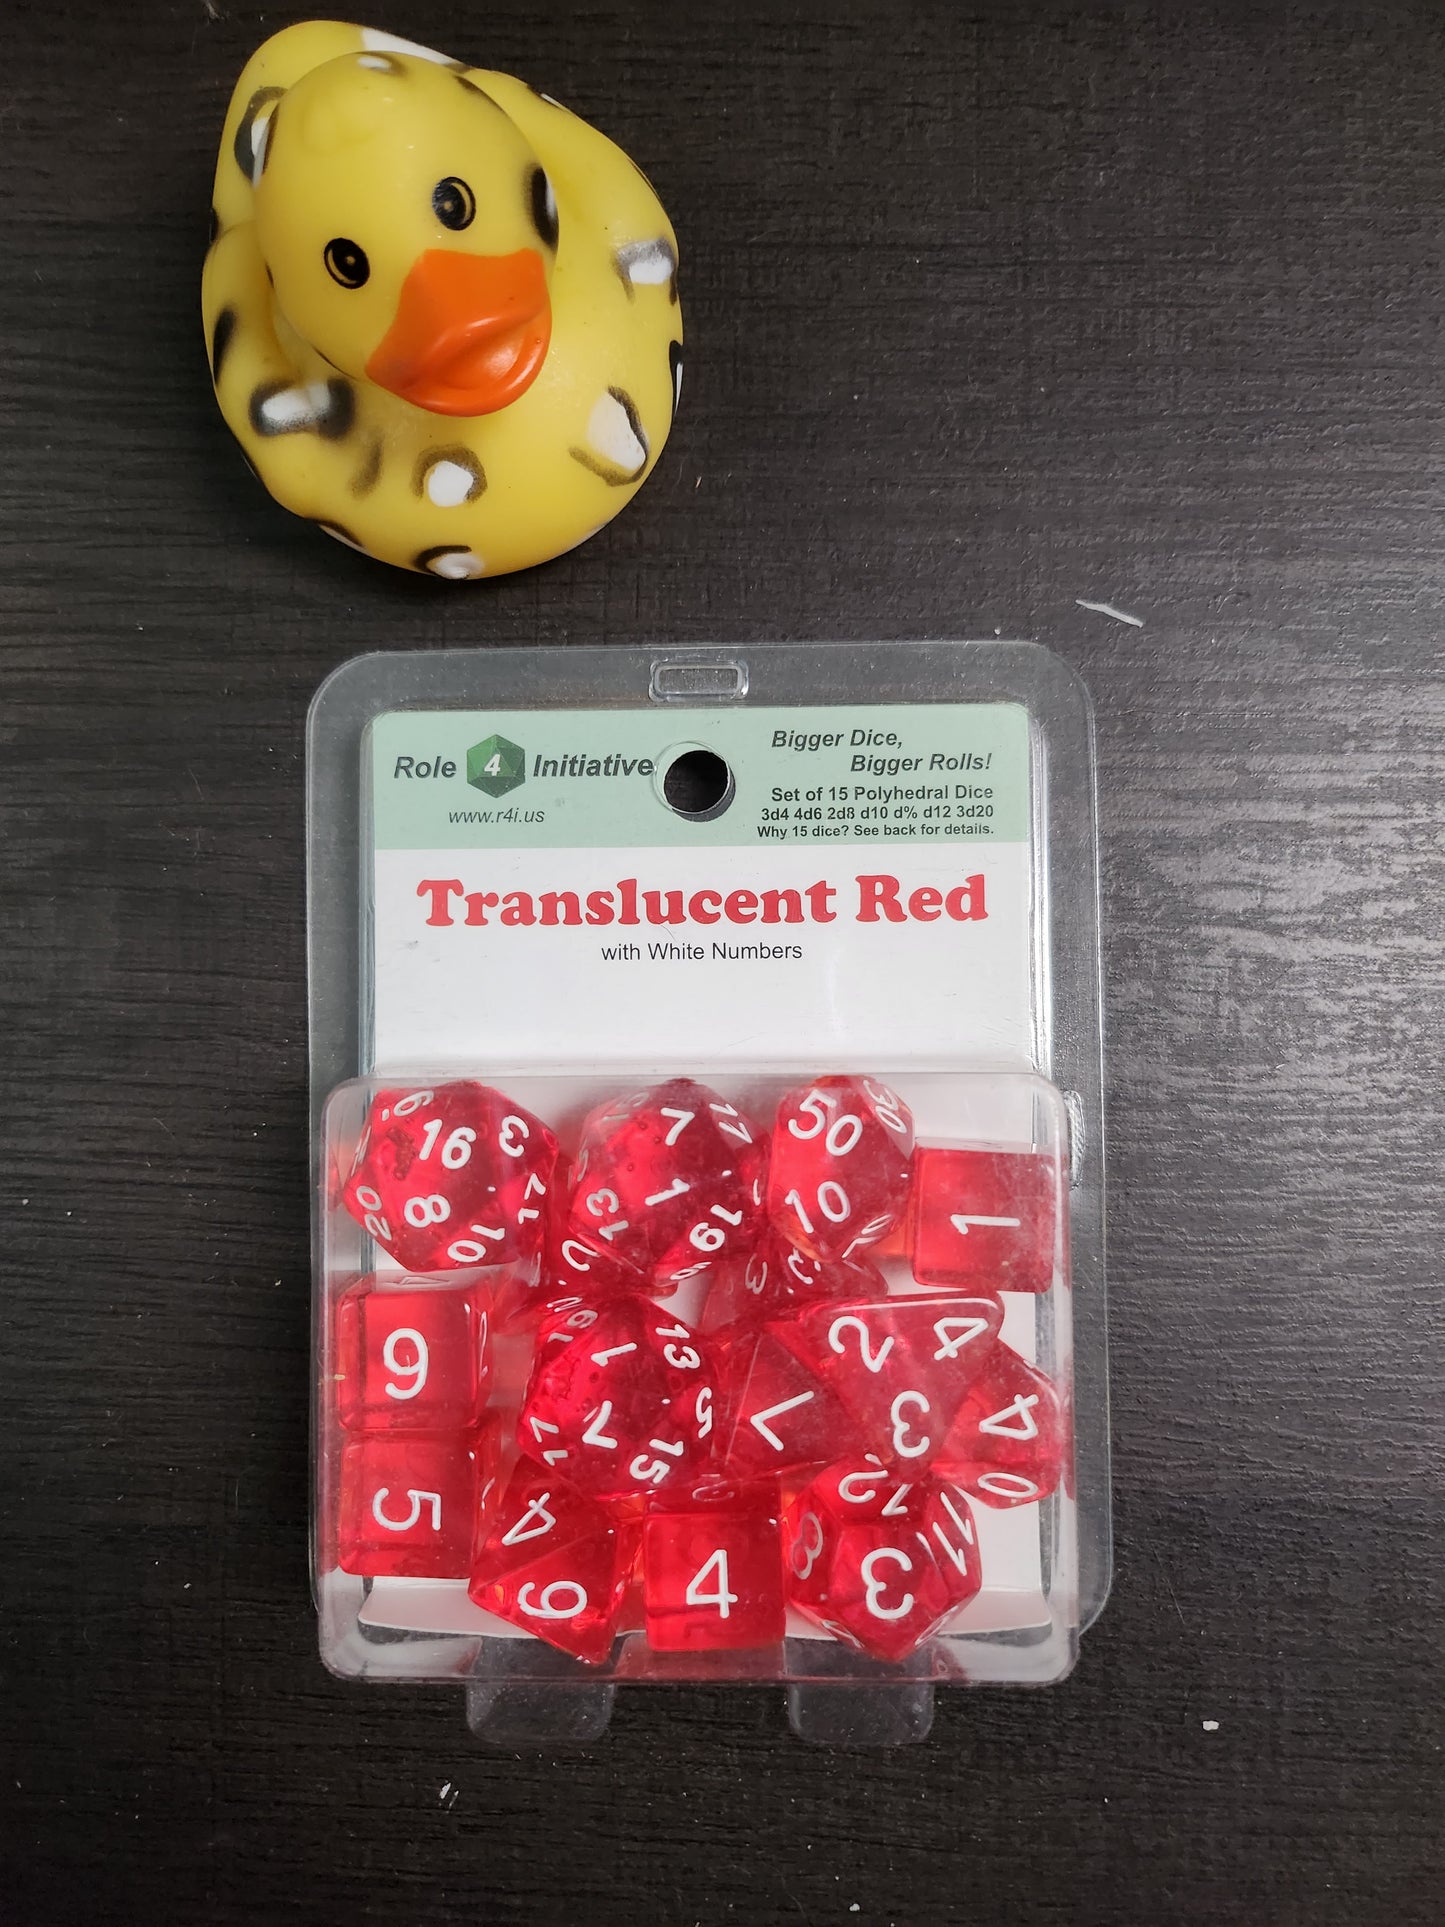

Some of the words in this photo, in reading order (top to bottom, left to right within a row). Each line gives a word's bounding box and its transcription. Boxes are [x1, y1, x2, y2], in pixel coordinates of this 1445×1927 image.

[771, 729, 844, 752] Bigger
[850, 729, 903, 749] Dice,
[393, 755, 457, 779] Role
[483, 753, 501, 777] 4
[533, 753, 655, 777] Initiative
[850, 755, 922, 776] Bigger
[929, 752, 992, 772] Rolls!
[448, 807, 546, 824] www.r4i.us
[761, 807, 790, 821] 3d4
[794, 807, 822, 820] 4d6
[827, 807, 855, 820] 2d8
[860, 806, 888, 820] d10
[893, 806, 918, 819] d%
[923, 805, 951, 819] d12
[956, 805, 994, 818] 3d20
[771, 787, 800, 802] Set
[805, 787, 823, 802] of
[829, 786, 848, 801] 15
[854, 785, 949, 804] Polyhedral
[955, 784, 993, 799] Dice
[757, 825, 788, 839] Why
[792, 825, 807, 838] 15
[811, 825, 849, 838] dice?
[854, 824, 879, 837] See
[884, 824, 916, 836] back
[921, 824, 940, 836] for
[944, 824, 994, 836] details.
[416, 878, 837, 927] Translucent
[855, 874, 989, 923] Red
[601, 943, 641, 961] with
[647, 943, 705, 961] White
[712, 942, 802, 960] Numbers
[418, 1118, 477, 1169] 16
[499, 1114, 530, 1158] 3
[788, 1089, 863, 1156] 50
[356, 1185, 392, 1241] 20
[403, 1194, 450, 1228] 8
[586, 1188, 629, 1241] 13
[784, 1180, 851, 1234] 10
[950, 1213, 1021, 1235] 1
[447, 1224, 506, 1263] 10
[590, 1342, 638, 1367] 1
[655, 1323, 701, 1370] 13
[828, 1315, 895, 1374] 2
[933, 1316, 989, 1360] 4
[890, 1390, 931, 1458] 3
[979, 1393, 1039, 1440] 4
[629, 1438, 684, 1484] 15
[977, 1472, 1039, 1499] 0
[372, 1487, 442, 1532] 5
[501, 1492, 557, 1546] 4
[686, 1549, 738, 1619] 4
[861, 1547, 914, 1621] 3
